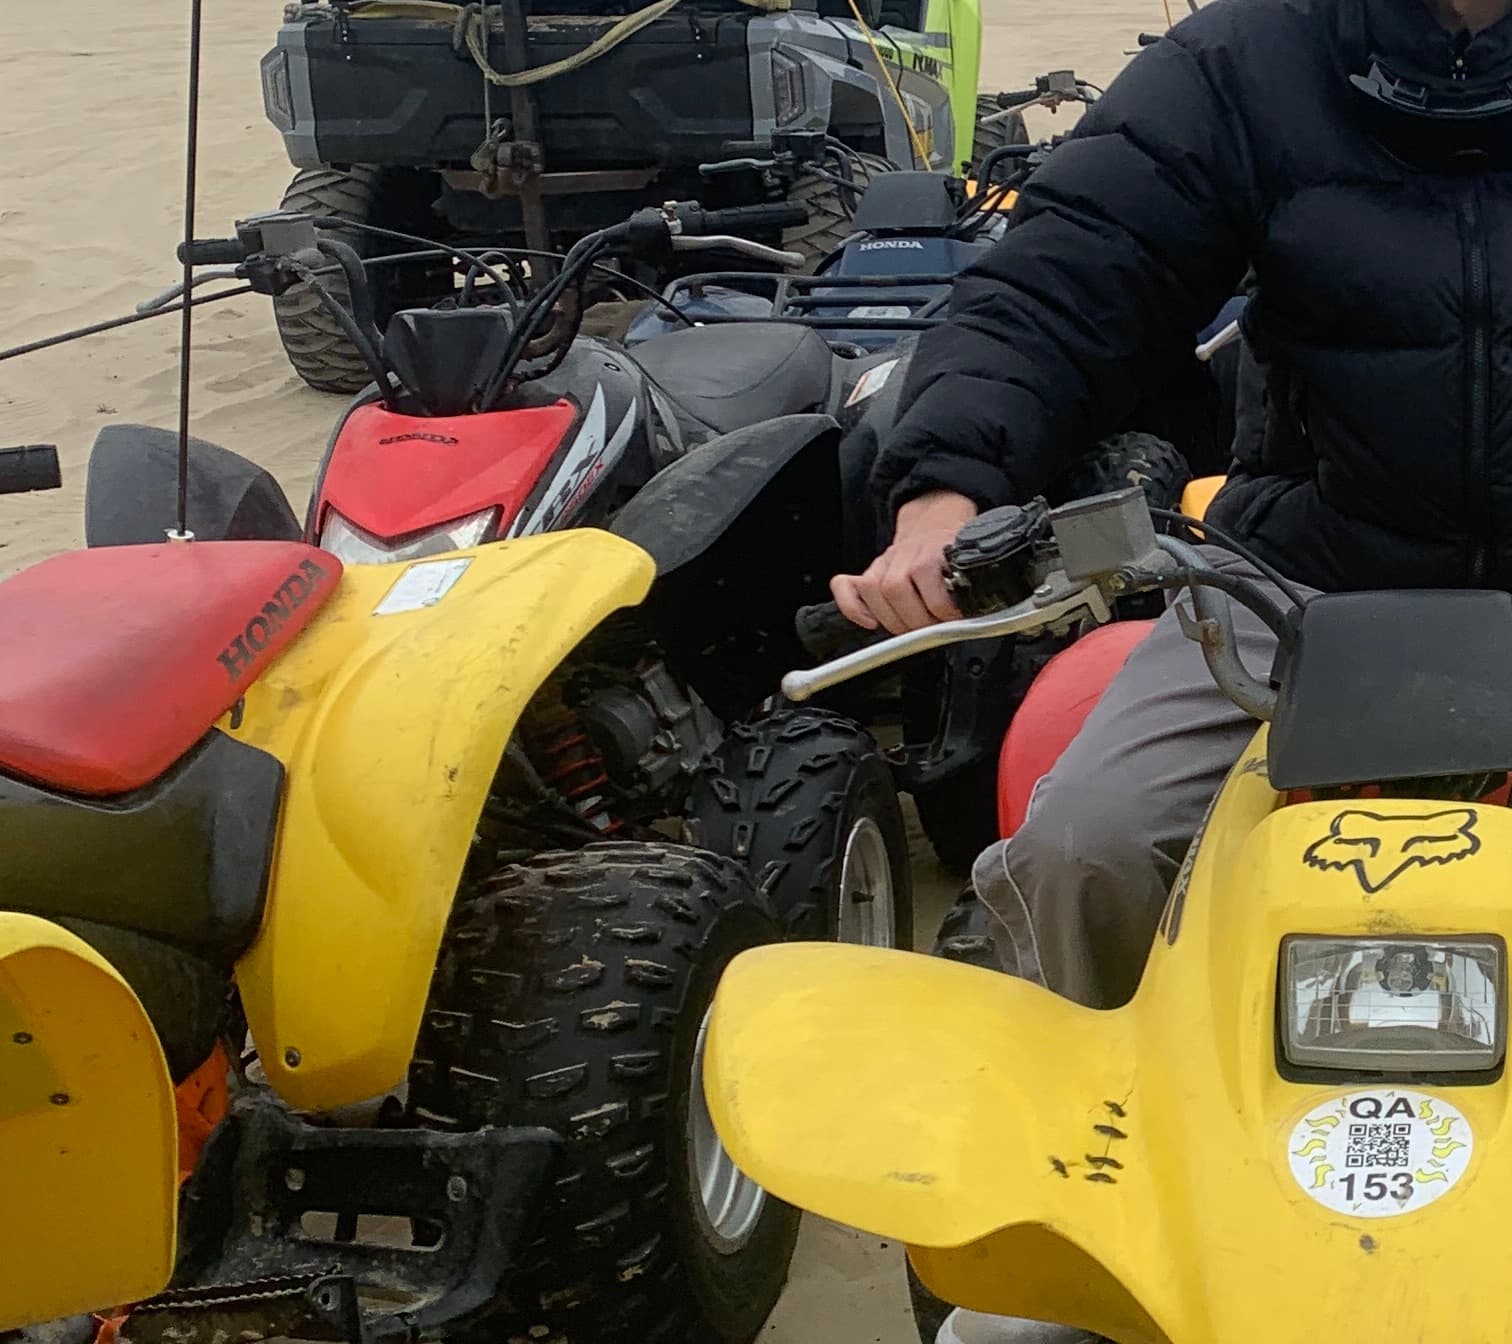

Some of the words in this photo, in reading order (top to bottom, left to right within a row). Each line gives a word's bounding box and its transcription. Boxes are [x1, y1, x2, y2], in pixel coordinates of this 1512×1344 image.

[859, 240, 924, 252] HONDA
[216, 559, 330, 681] HONDA
[1350, 1097, 1416, 1119] QA
[1339, 1172, 1414, 1201] 153
